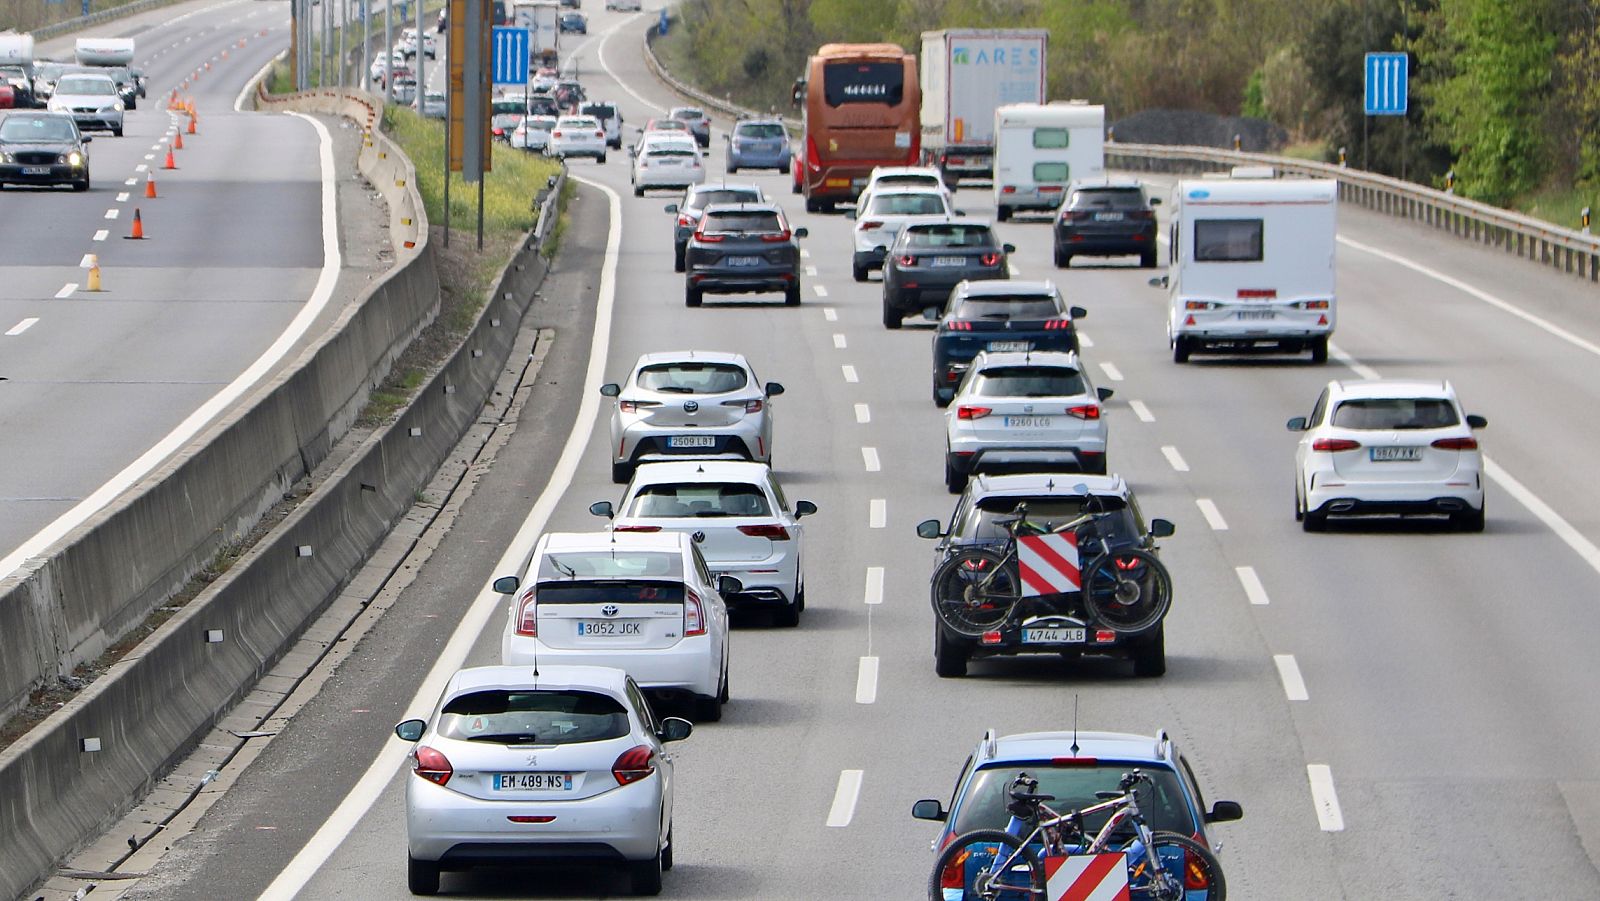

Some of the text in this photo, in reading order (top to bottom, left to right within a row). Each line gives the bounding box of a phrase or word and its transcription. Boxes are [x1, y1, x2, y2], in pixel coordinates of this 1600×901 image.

[975, 47, 1038, 65] ARES
[673, 437, 713, 446] 2509 LBT
[585, 623, 641, 635] 3052 JCK
[1029, 630, 1084, 641] 4744 JLB
[471, 717, 483, 730] A
